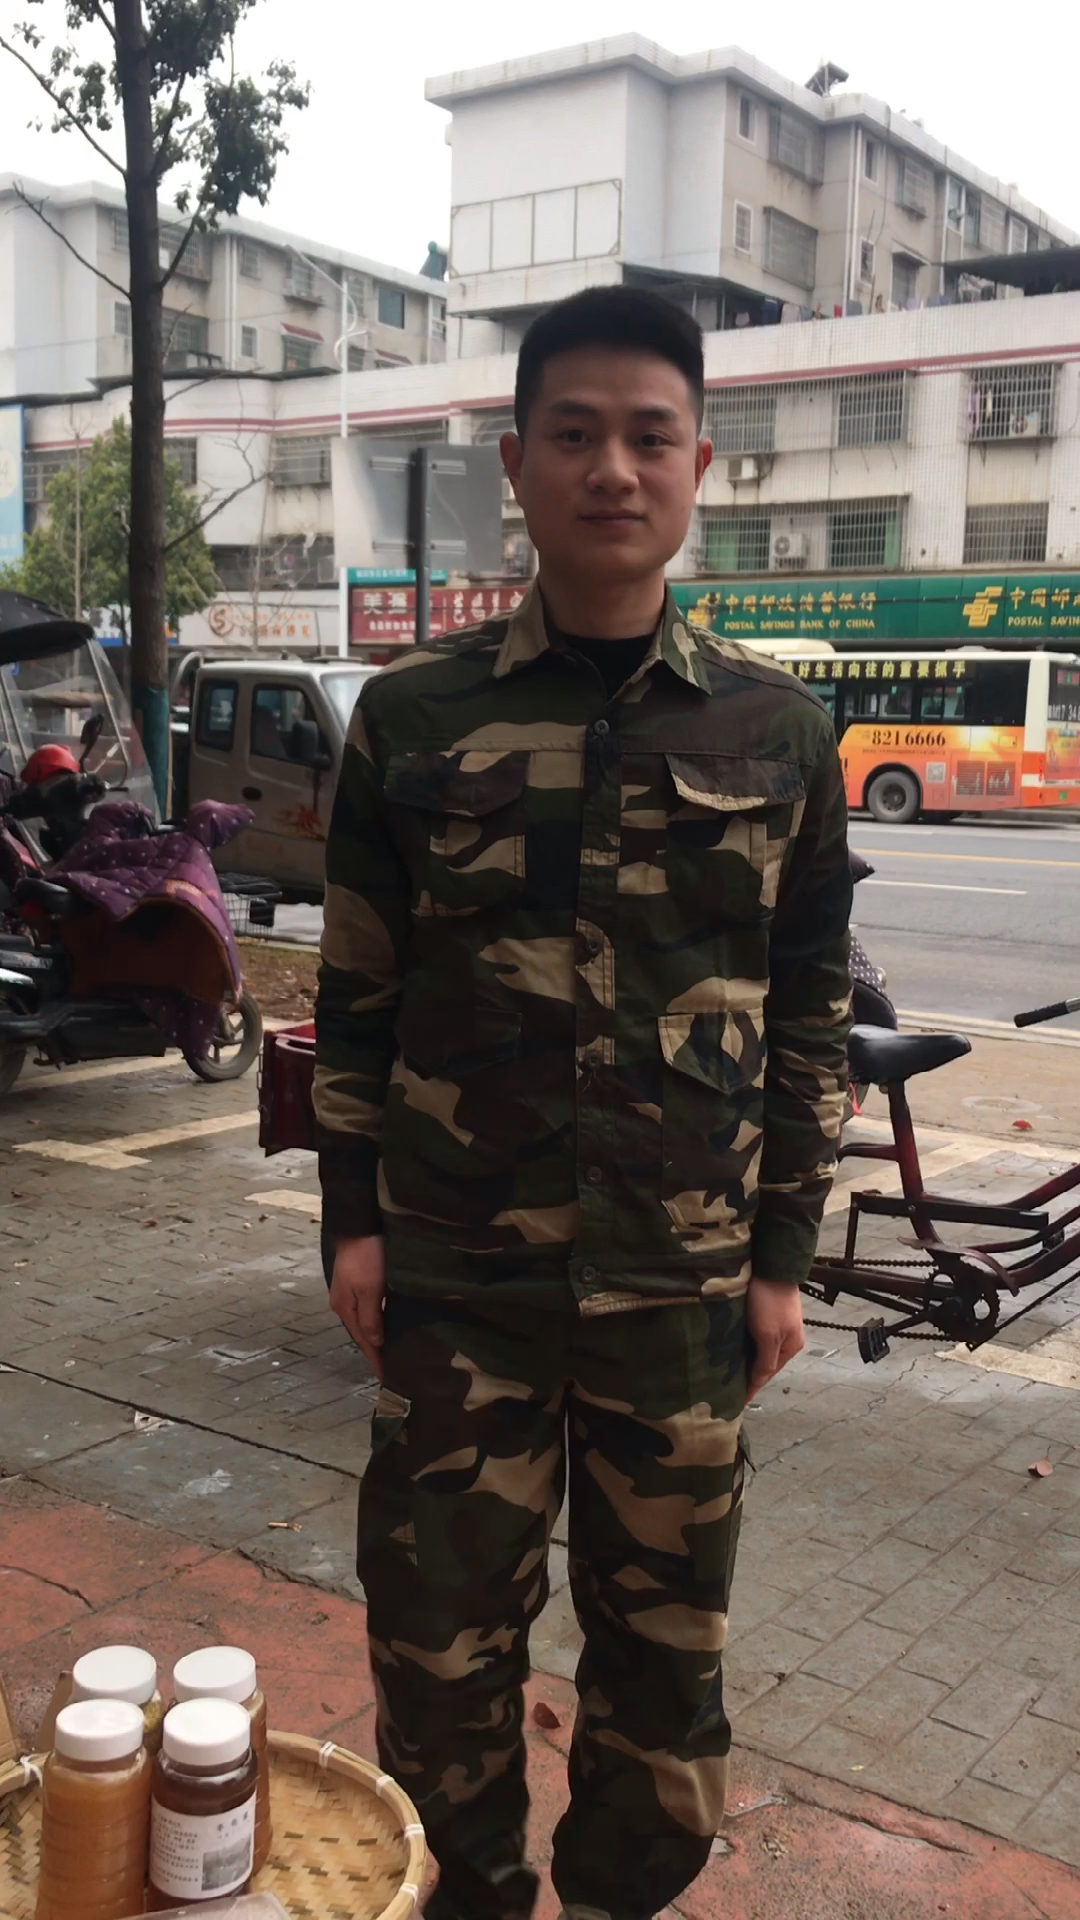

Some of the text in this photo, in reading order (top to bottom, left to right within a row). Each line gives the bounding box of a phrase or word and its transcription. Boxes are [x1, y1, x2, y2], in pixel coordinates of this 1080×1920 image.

[725, 591, 877, 615] 中国邮政储蓄银行
[724, 618, 875, 630] POSTAL SAVINGS BANK OF CHINA
[1008, 616, 1044, 626] POSTAL
